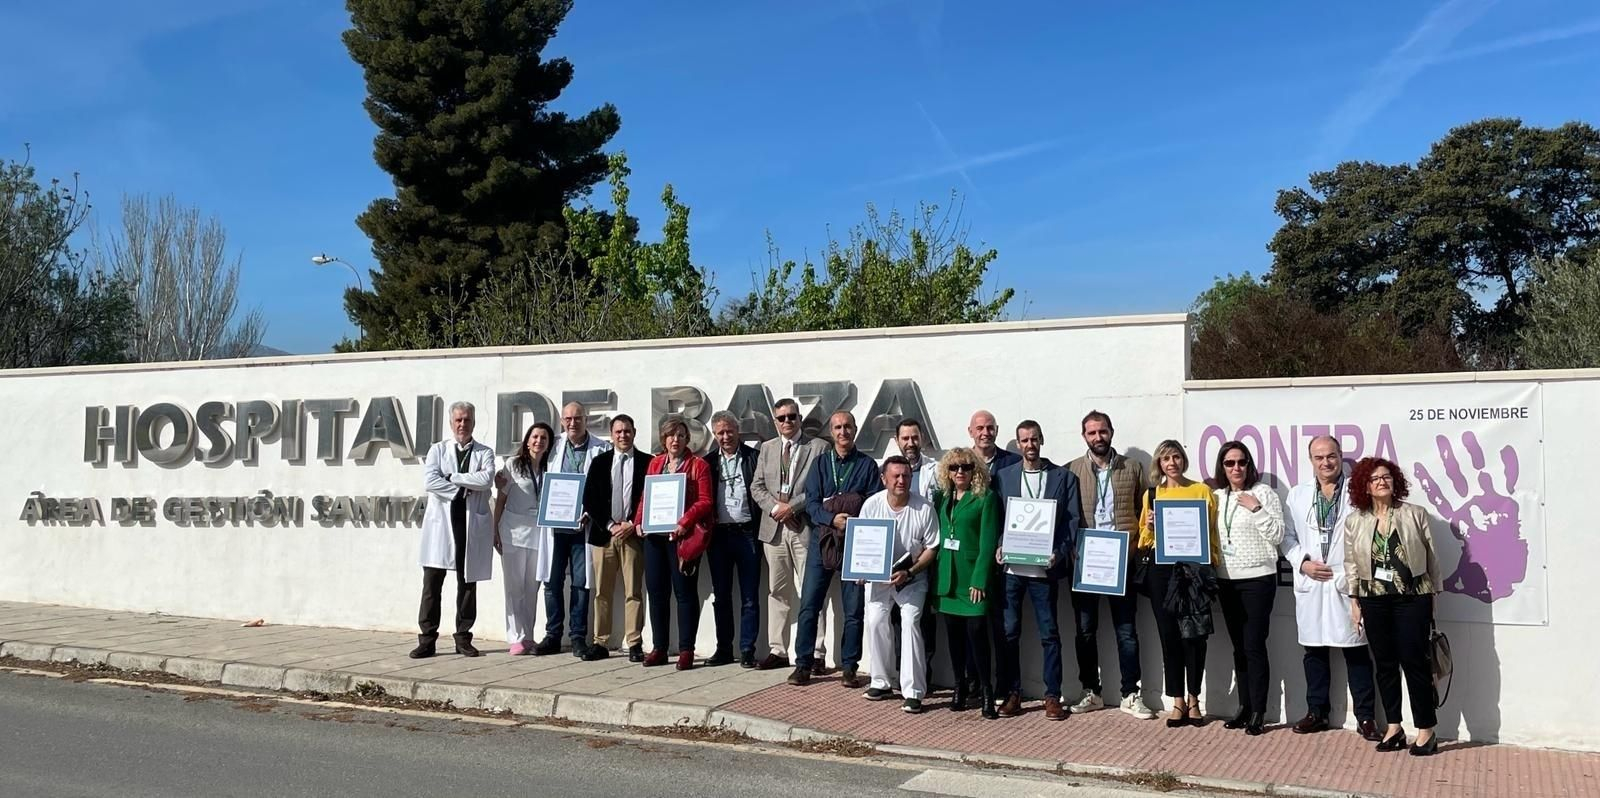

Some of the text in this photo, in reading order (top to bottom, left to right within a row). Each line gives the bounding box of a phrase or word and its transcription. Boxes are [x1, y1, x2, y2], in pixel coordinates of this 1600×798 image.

[84, 378, 942, 464] HOSPITAL DE BAZA
[1409, 406, 1529, 421] 25 DE NOVIEMBRE
[19, 490, 104, 524] ÁREA
[110, 496, 157, 524] DE
[163, 489, 303, 524] GESTIÓN
